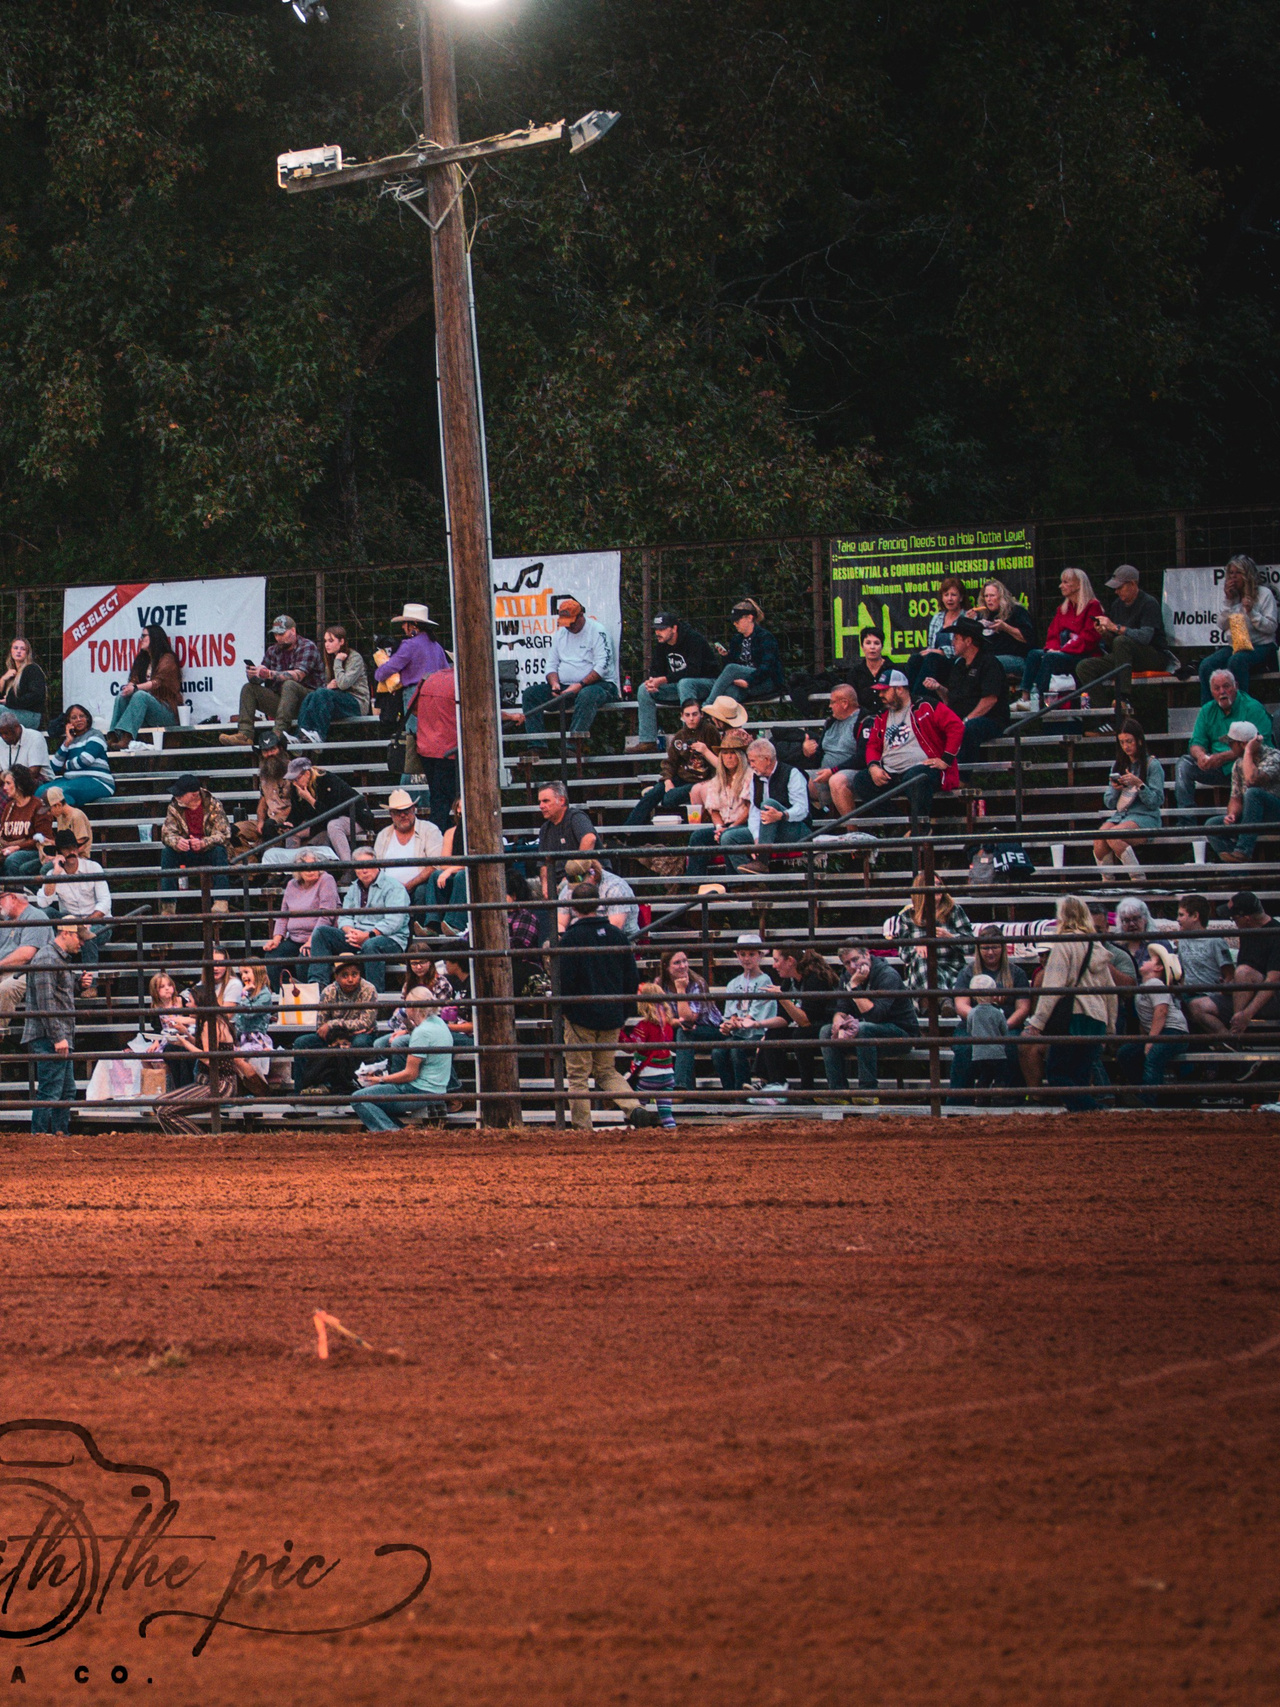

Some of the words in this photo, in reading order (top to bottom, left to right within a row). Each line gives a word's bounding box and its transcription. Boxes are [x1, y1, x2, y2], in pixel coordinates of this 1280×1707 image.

[837, 539, 856, 552] Take
[858, 540, 876, 553] your
[878, 538, 908, 551] Fencing
[909, 535, 936, 548] Needs
[937, 534, 947, 546] to
[949, 535, 955, 545] a
[956, 532, 975, 545] Hole
[976, 531, 1002, 544] Notha
[1004, 528, 1026, 542] Level
[832, 566, 882, 580] RESIDENTIAL
[883, 567, 890, 578] &
[890, 561, 945, 577] COMMERCIAL
[949, 559, 989, 574] LICENSED
[989, 560, 996, 571] &
[996, 555, 1034, 570] INSURED
[862, 583, 903, 595] Aluminum,
[71, 593, 120, 641] RE-ELECT
[137, 604, 187, 628] VOTE
[893, 630, 928, 649] FEN
[88, 638, 142, 673] TOMM
[172, 633, 236, 668] DKINS
[993, 851, 1026, 868] LIFE
